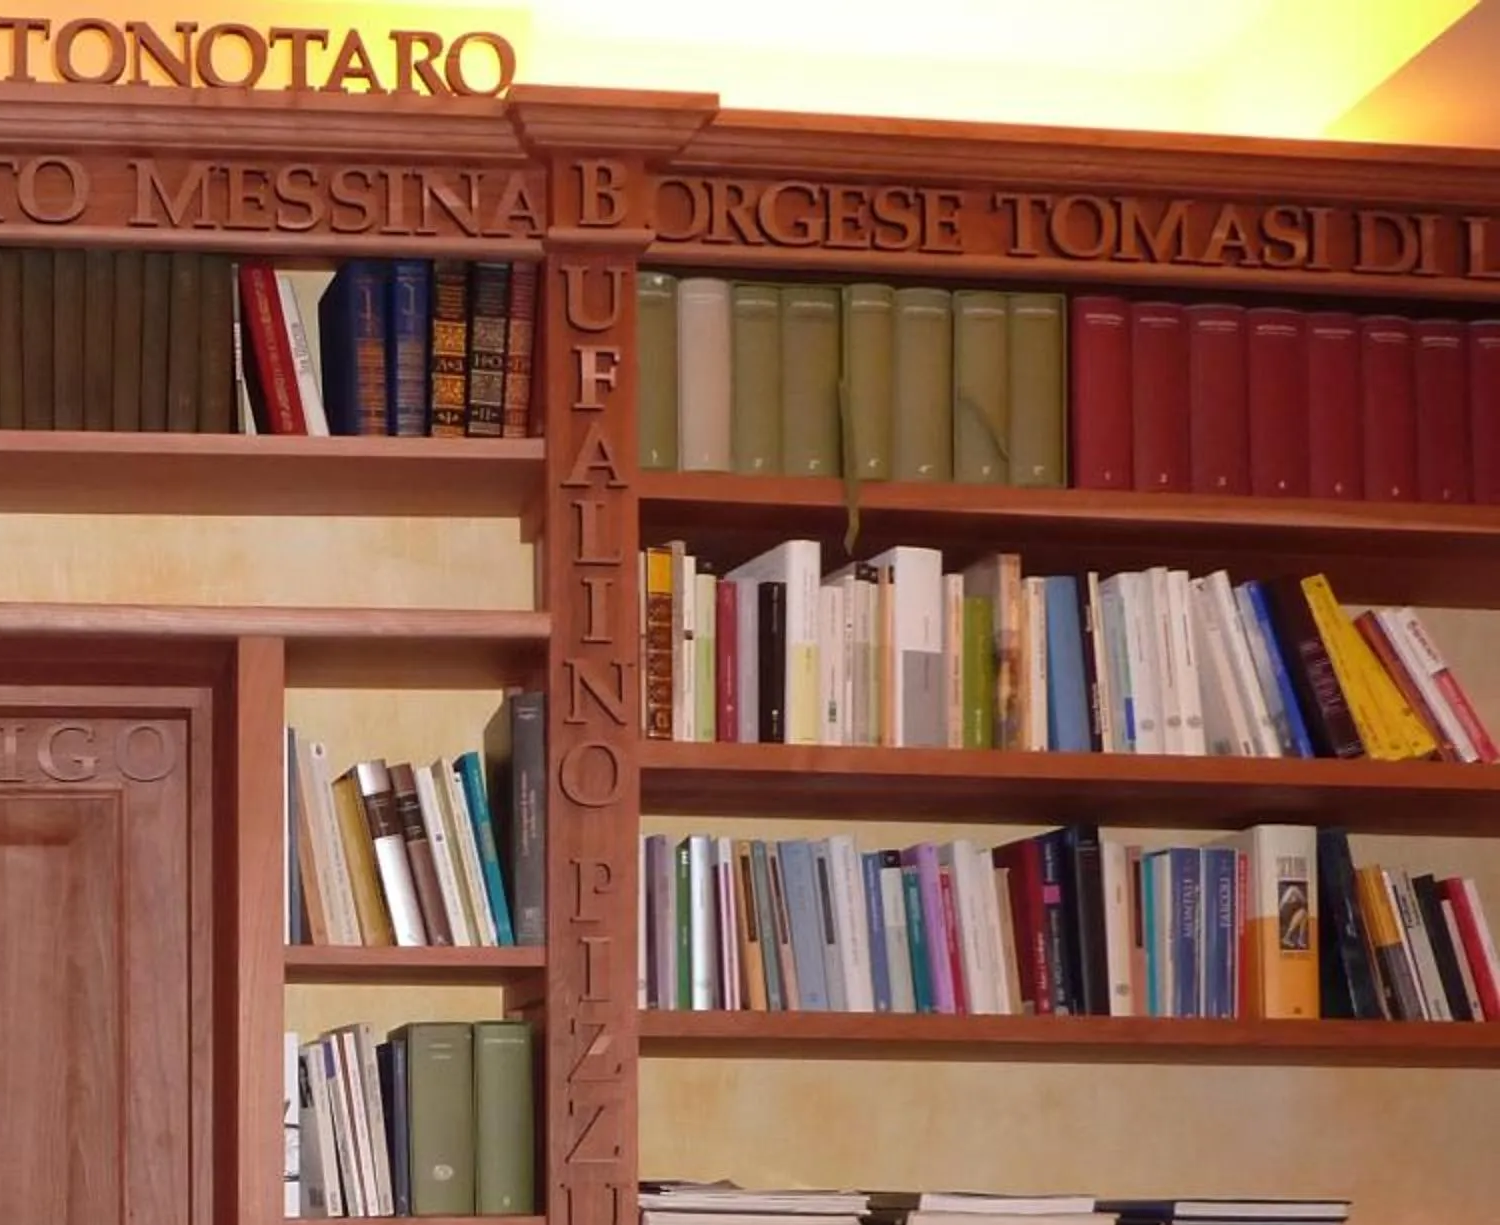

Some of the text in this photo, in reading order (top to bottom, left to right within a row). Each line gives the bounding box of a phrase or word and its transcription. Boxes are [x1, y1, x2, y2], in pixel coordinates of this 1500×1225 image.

[126, 156, 546, 240] MESSINA
[992, 191, 1337, 273] TOMASI
[1349, 207, 1445, 279] DI
[557, 157, 635, 809] BUFALINO
